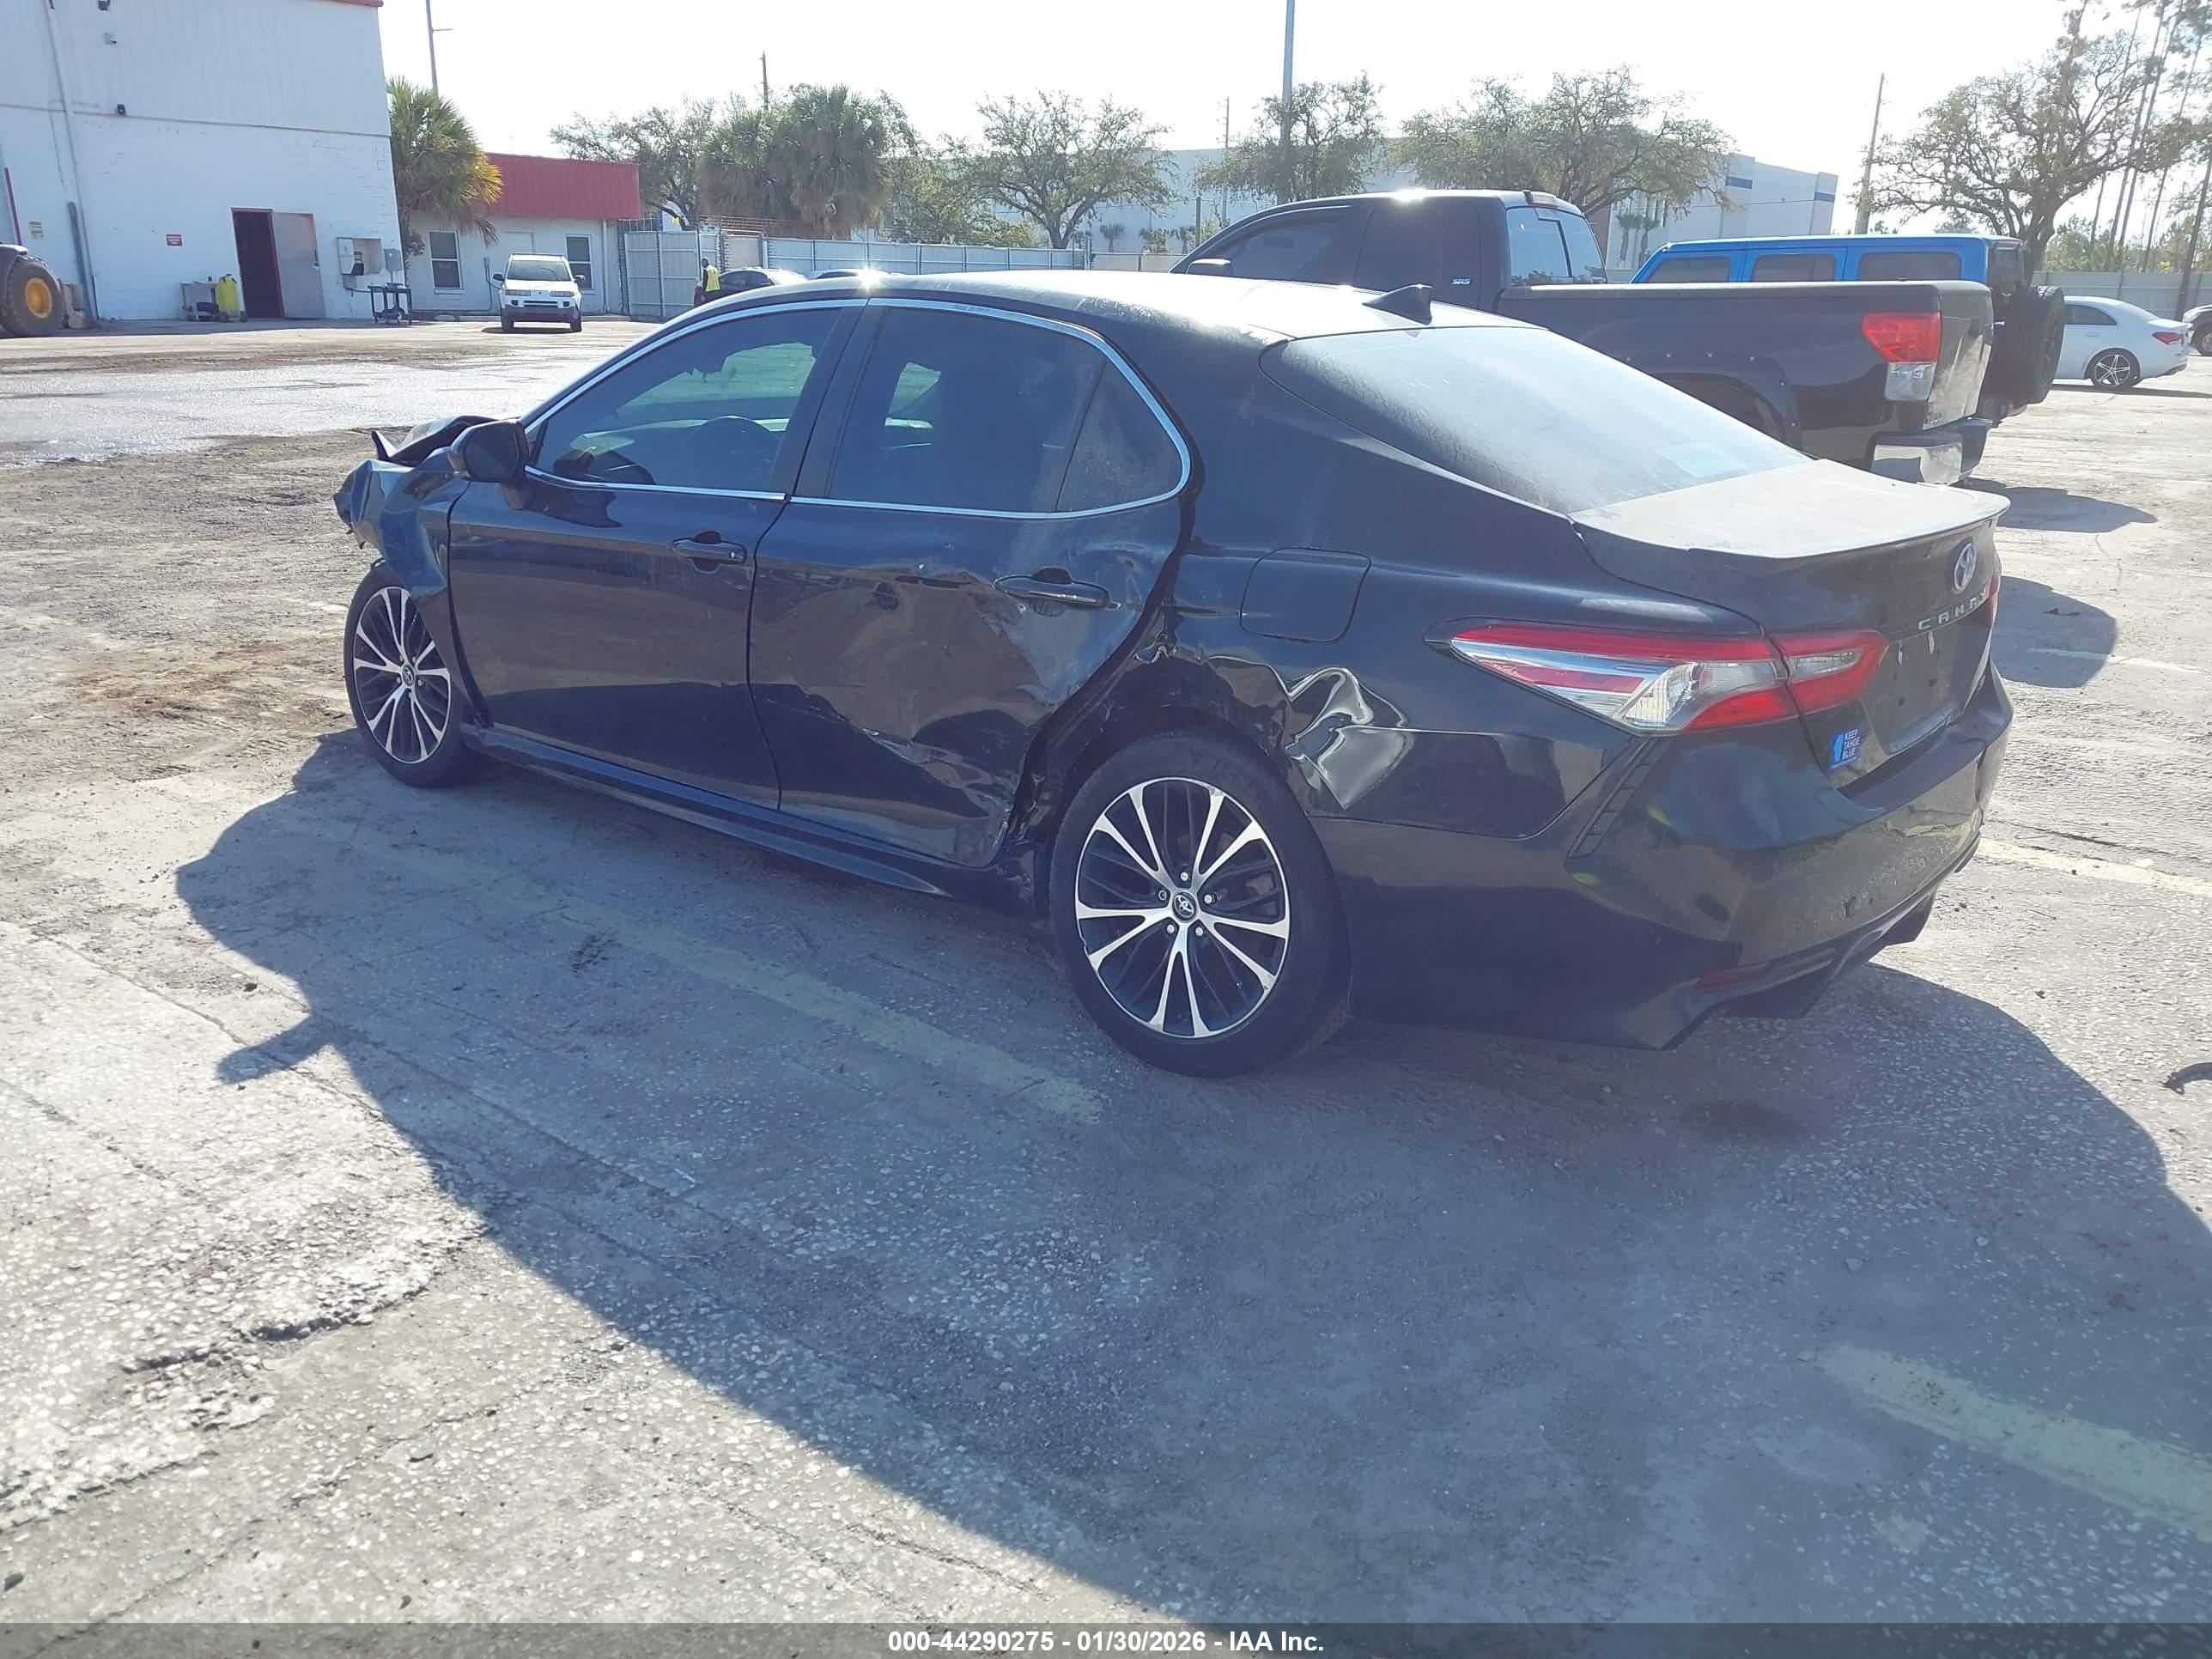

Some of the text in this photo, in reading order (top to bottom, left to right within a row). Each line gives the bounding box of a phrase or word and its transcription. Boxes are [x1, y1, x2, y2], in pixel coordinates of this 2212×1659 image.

[1844, 729, 1858, 742] KEEP
[1844, 736, 1861, 750] TAHOE
[1842, 747, 1856, 760] BLUE
